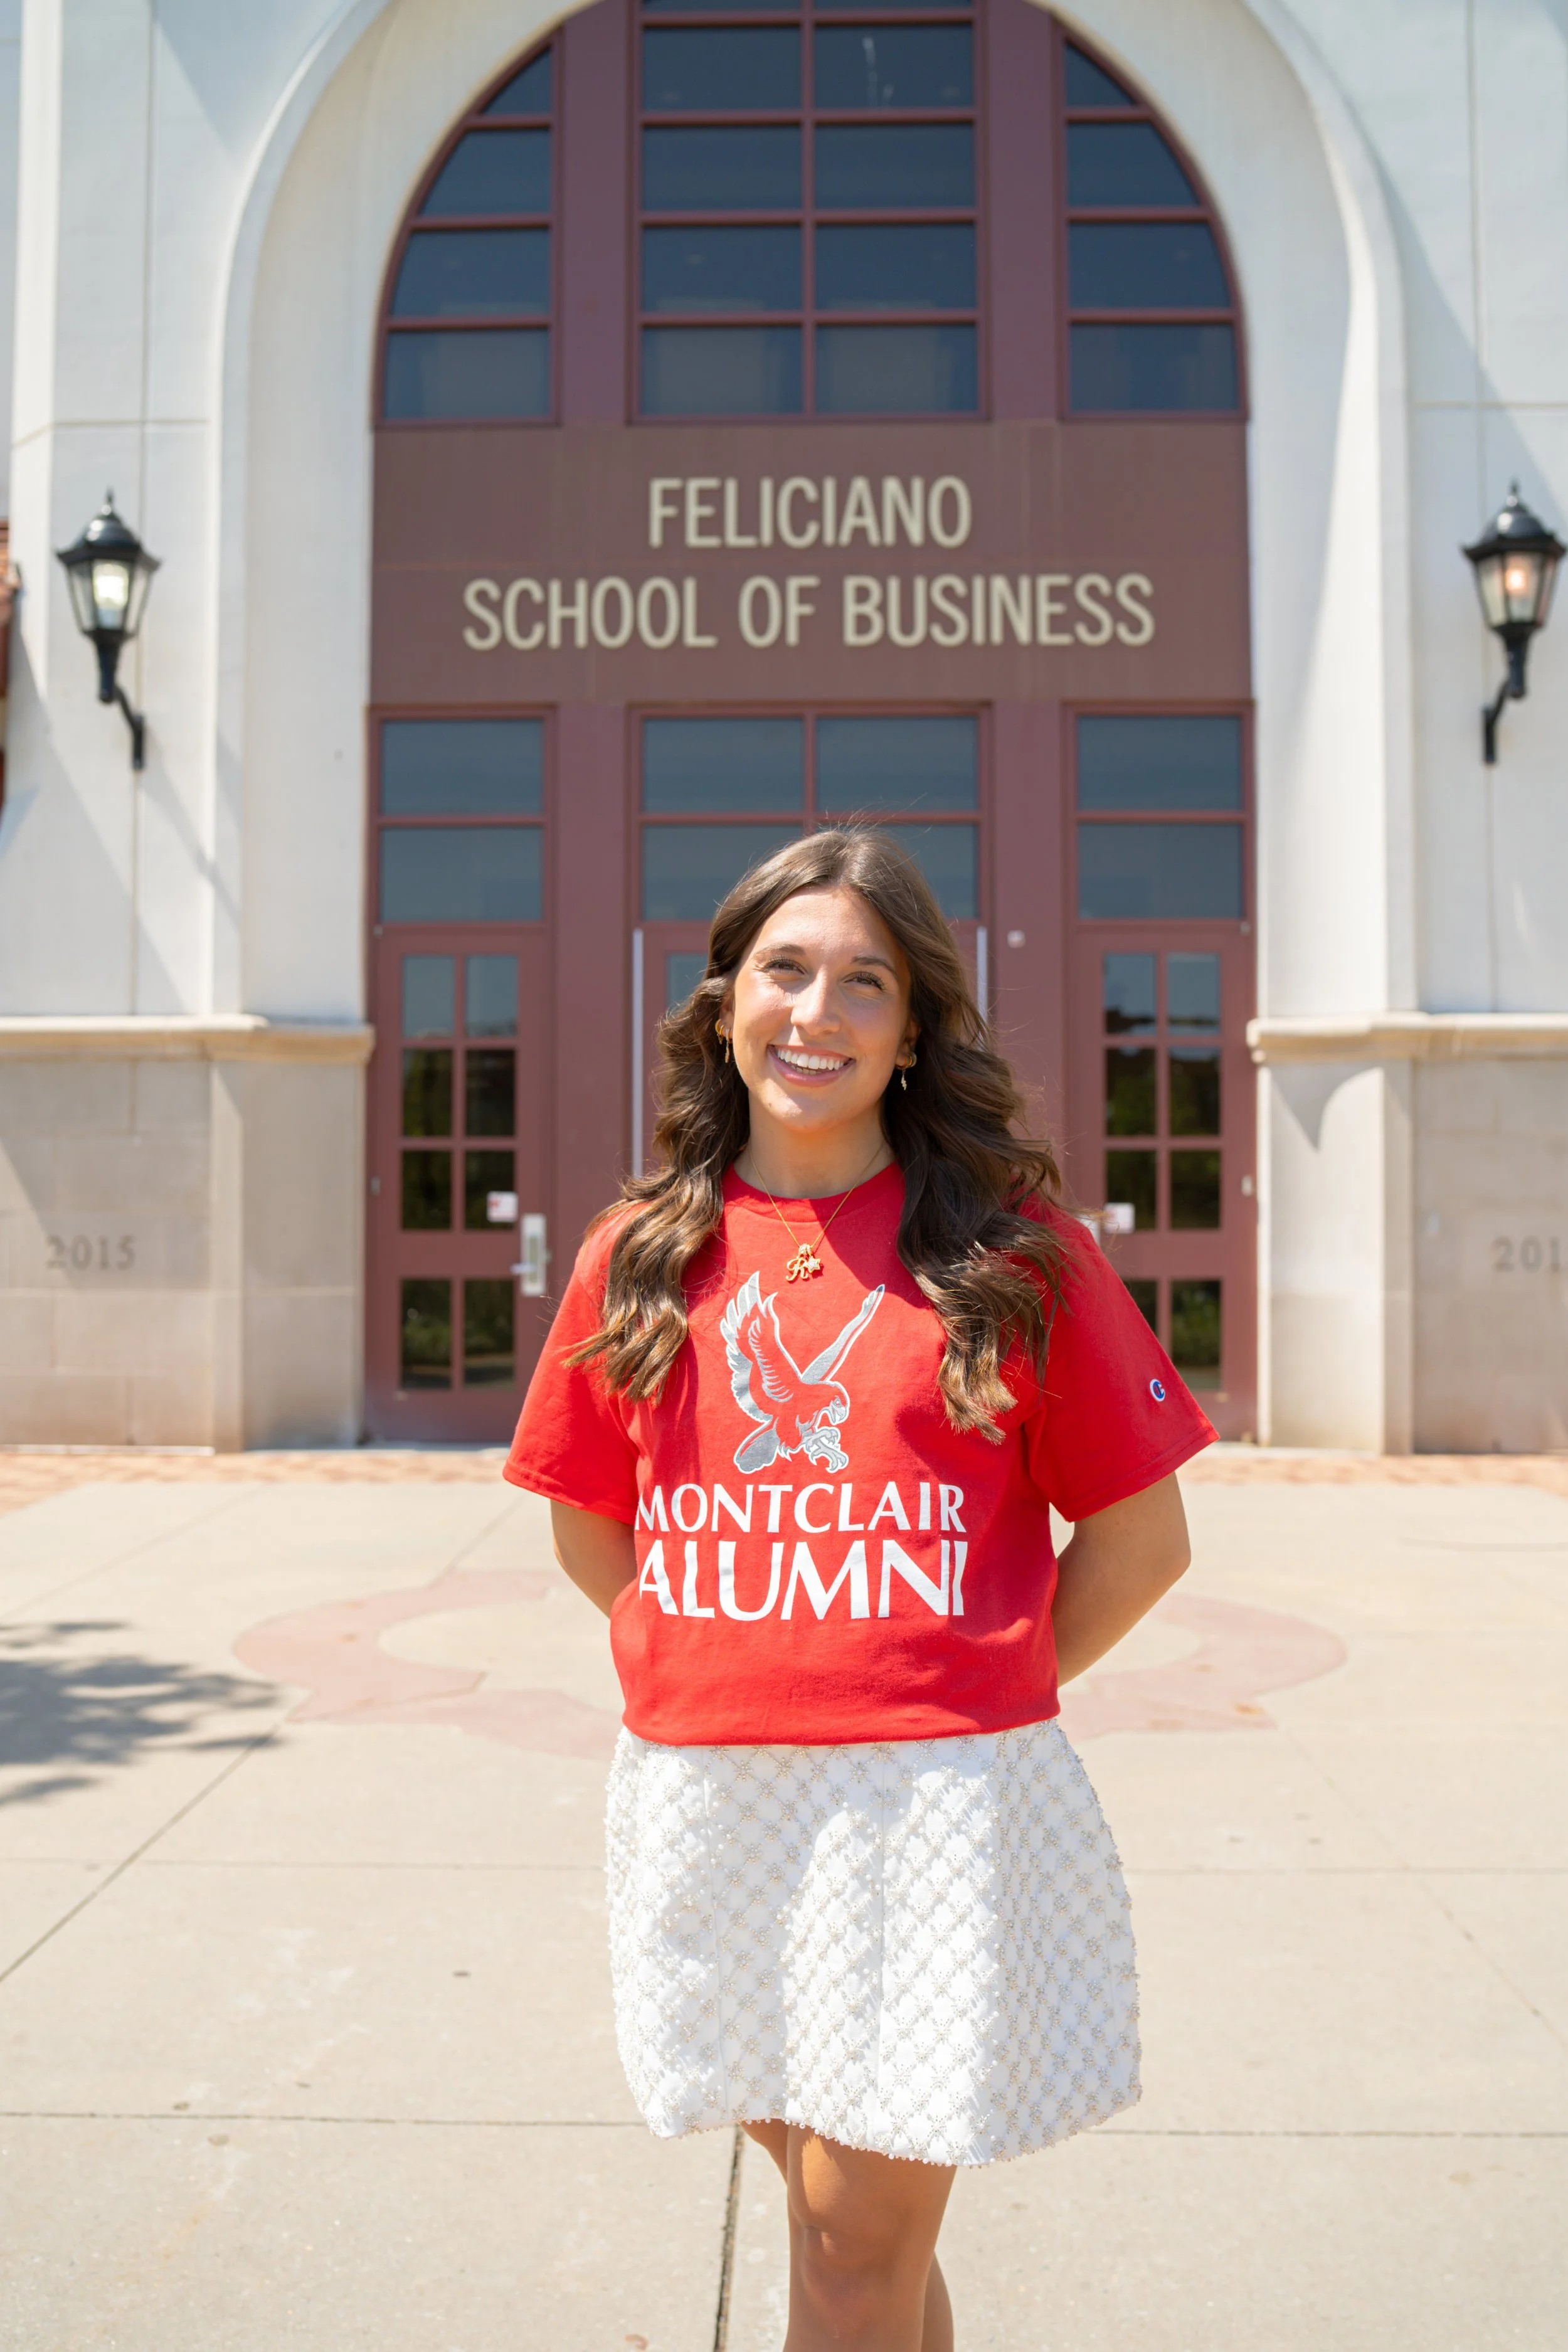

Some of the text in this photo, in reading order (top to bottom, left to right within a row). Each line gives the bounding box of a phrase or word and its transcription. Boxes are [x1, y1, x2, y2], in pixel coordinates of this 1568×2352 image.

[648, 475, 973, 549] FELICIANO
[462, 573, 1156, 650] SCHOOL OF BUSINESS
[45, 1234, 137, 1271] 2015
[634, 1481, 967, 1534] MONTCLAIR
[638, 1539, 968, 1621] ALUMNI
